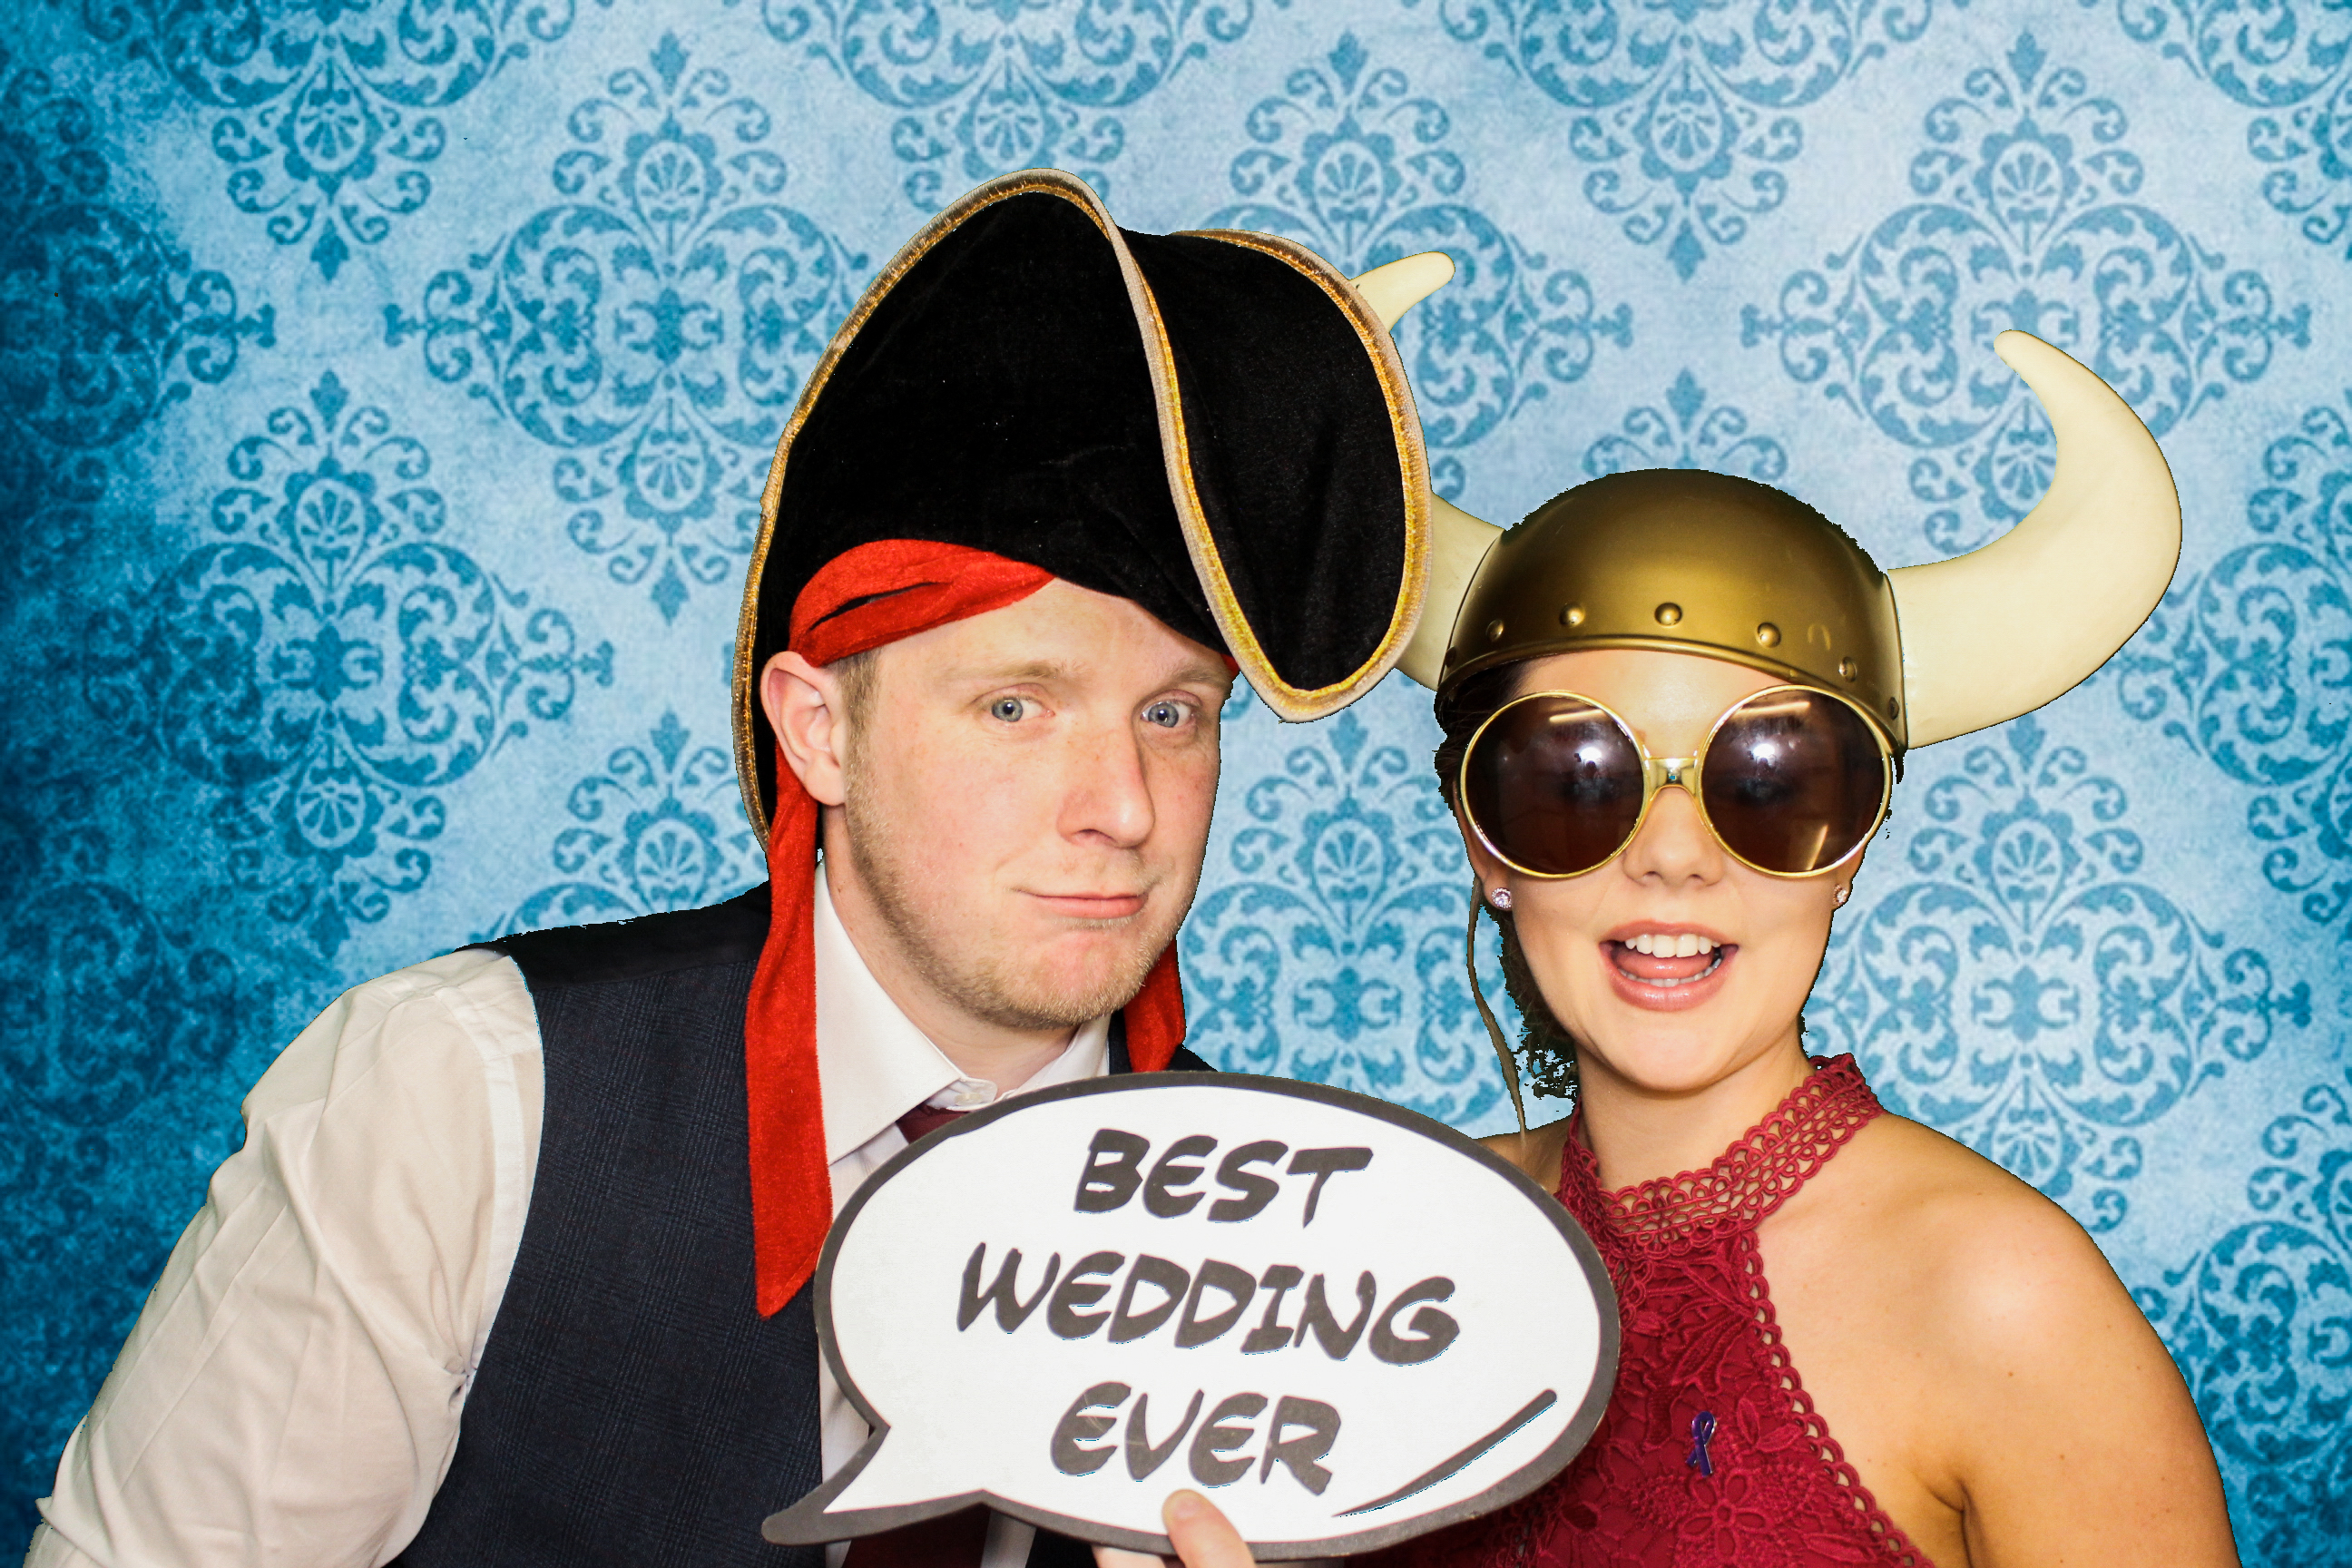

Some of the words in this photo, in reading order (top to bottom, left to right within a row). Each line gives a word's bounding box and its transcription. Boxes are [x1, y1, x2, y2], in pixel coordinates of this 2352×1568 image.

[1074, 1128, 1373, 1227] BEST
[957, 1242, 1459, 1365] WEDDING
[1051, 1382, 1342, 1495] EVER
